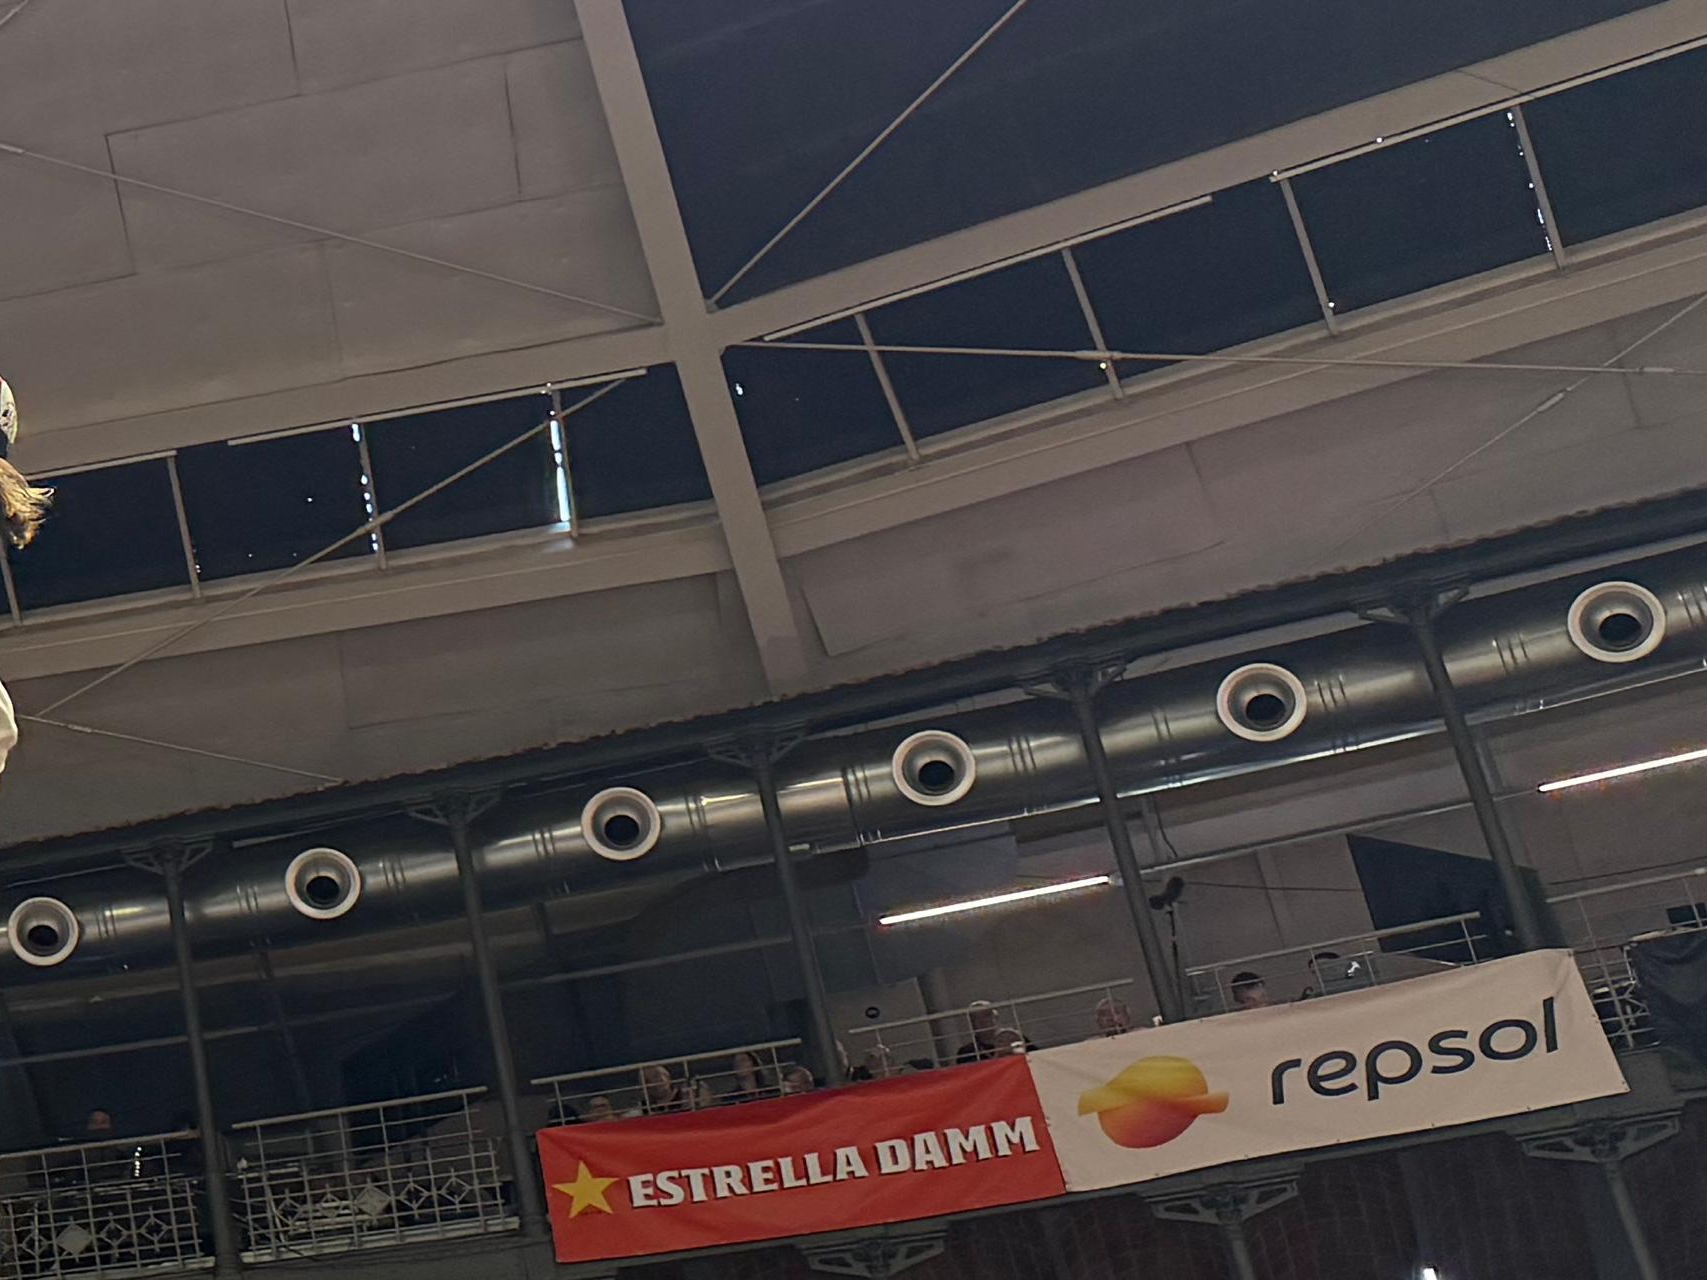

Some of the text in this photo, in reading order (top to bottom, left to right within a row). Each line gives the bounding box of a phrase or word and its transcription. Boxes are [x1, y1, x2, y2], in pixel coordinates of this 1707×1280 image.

[1272, 996, 1560, 1104] repsol
[628, 1115, 1040, 1209] ESTRELLA DAMM
